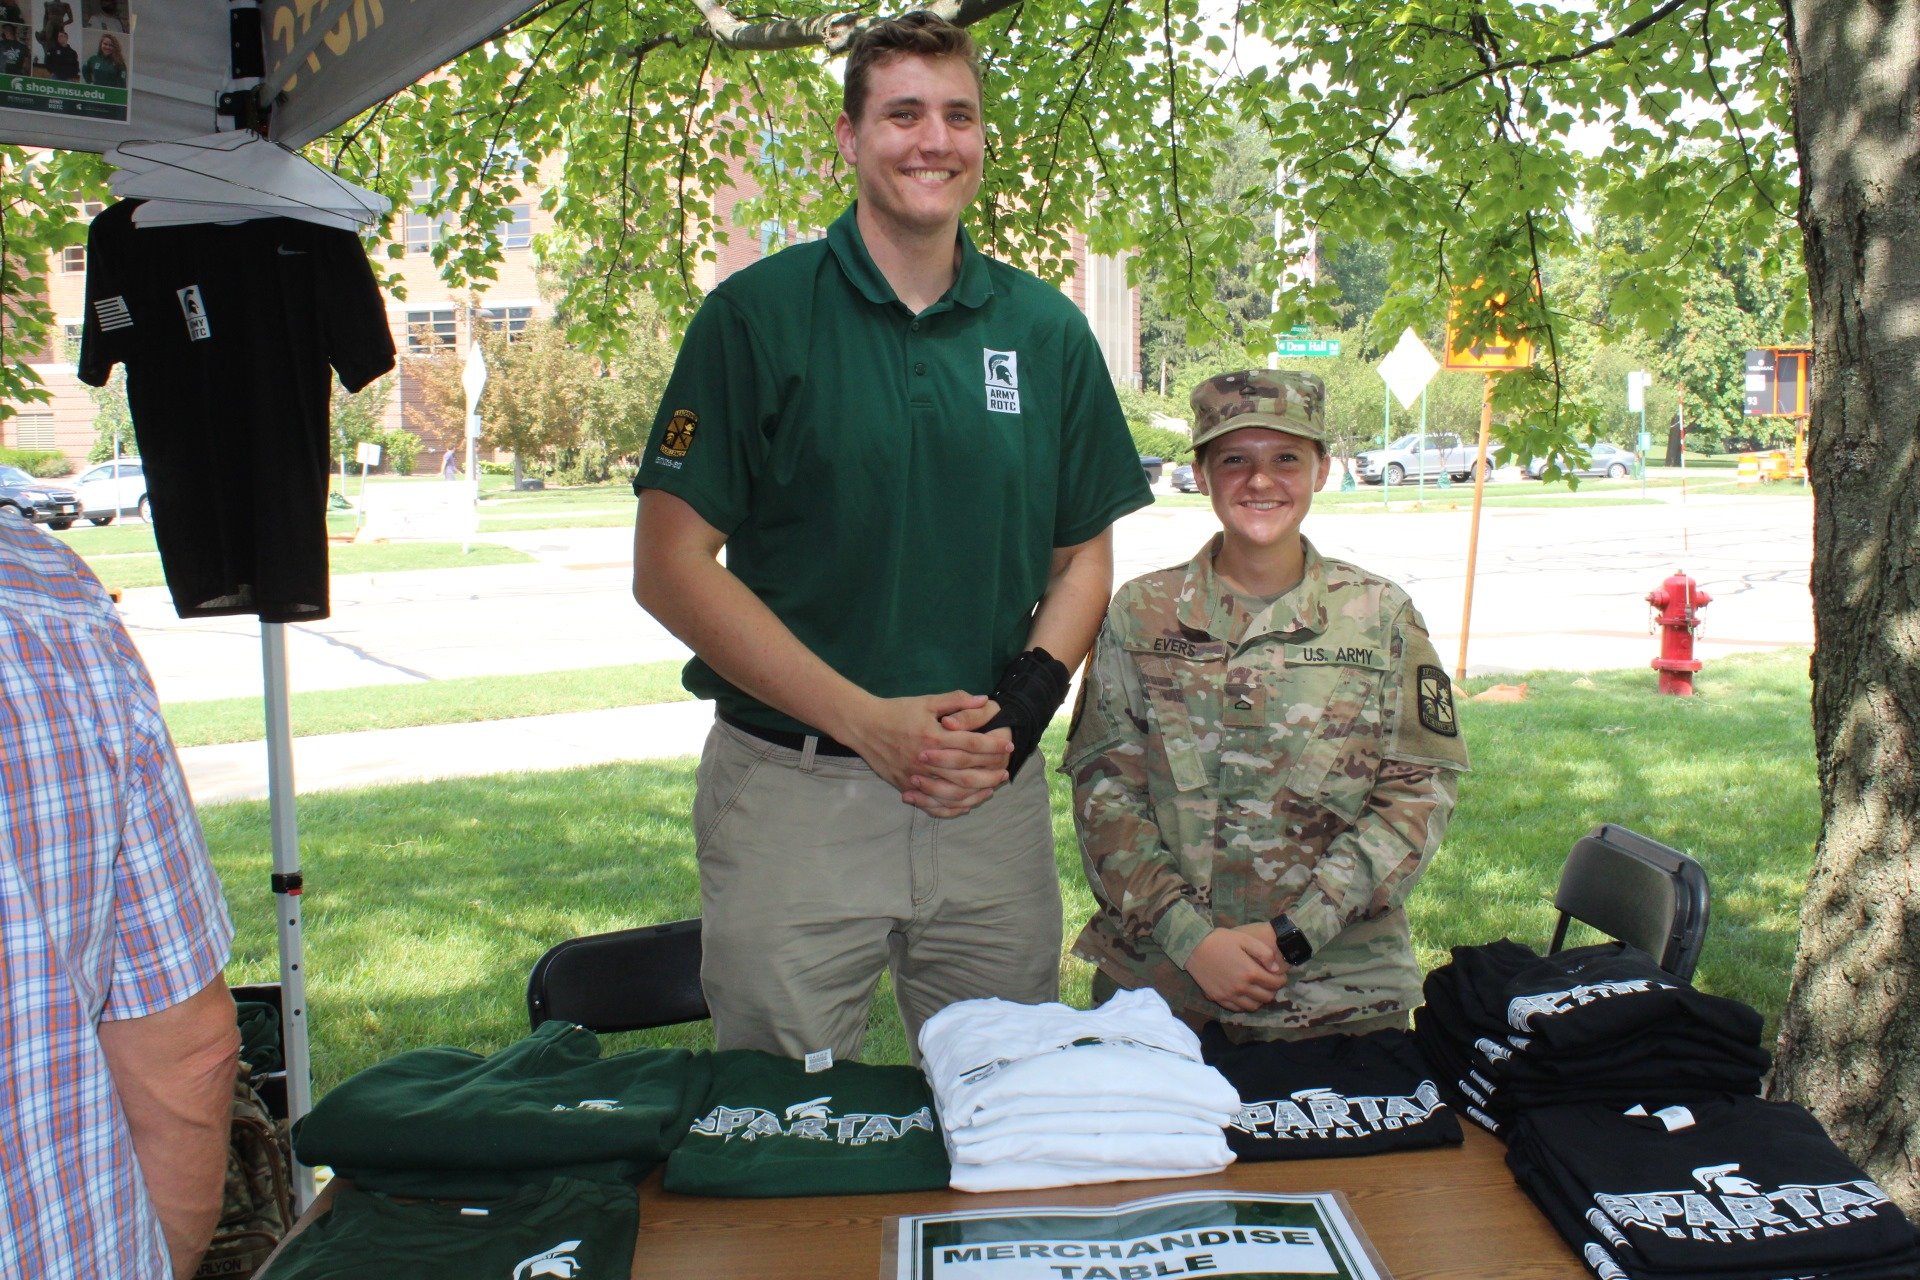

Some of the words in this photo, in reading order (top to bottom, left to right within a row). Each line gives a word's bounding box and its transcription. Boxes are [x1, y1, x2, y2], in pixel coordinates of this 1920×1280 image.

[26, 82, 106, 100] shop.msu.edu
[1309, 341, 1327, 351] Hall
[990, 388, 1015, 400] ARMY
[990, 399, 1016, 411] ROTC
[1153, 637, 1196, 657] EVERS
[1303, 647, 1329, 662] U.S.
[1335, 647, 1373, 665] ARMY
[1664, 1205, 1878, 1243] BATTALION
[943, 1229, 1315, 1264] MERCHANDISE
[1050, 1253, 1218, 1280] TABLE
